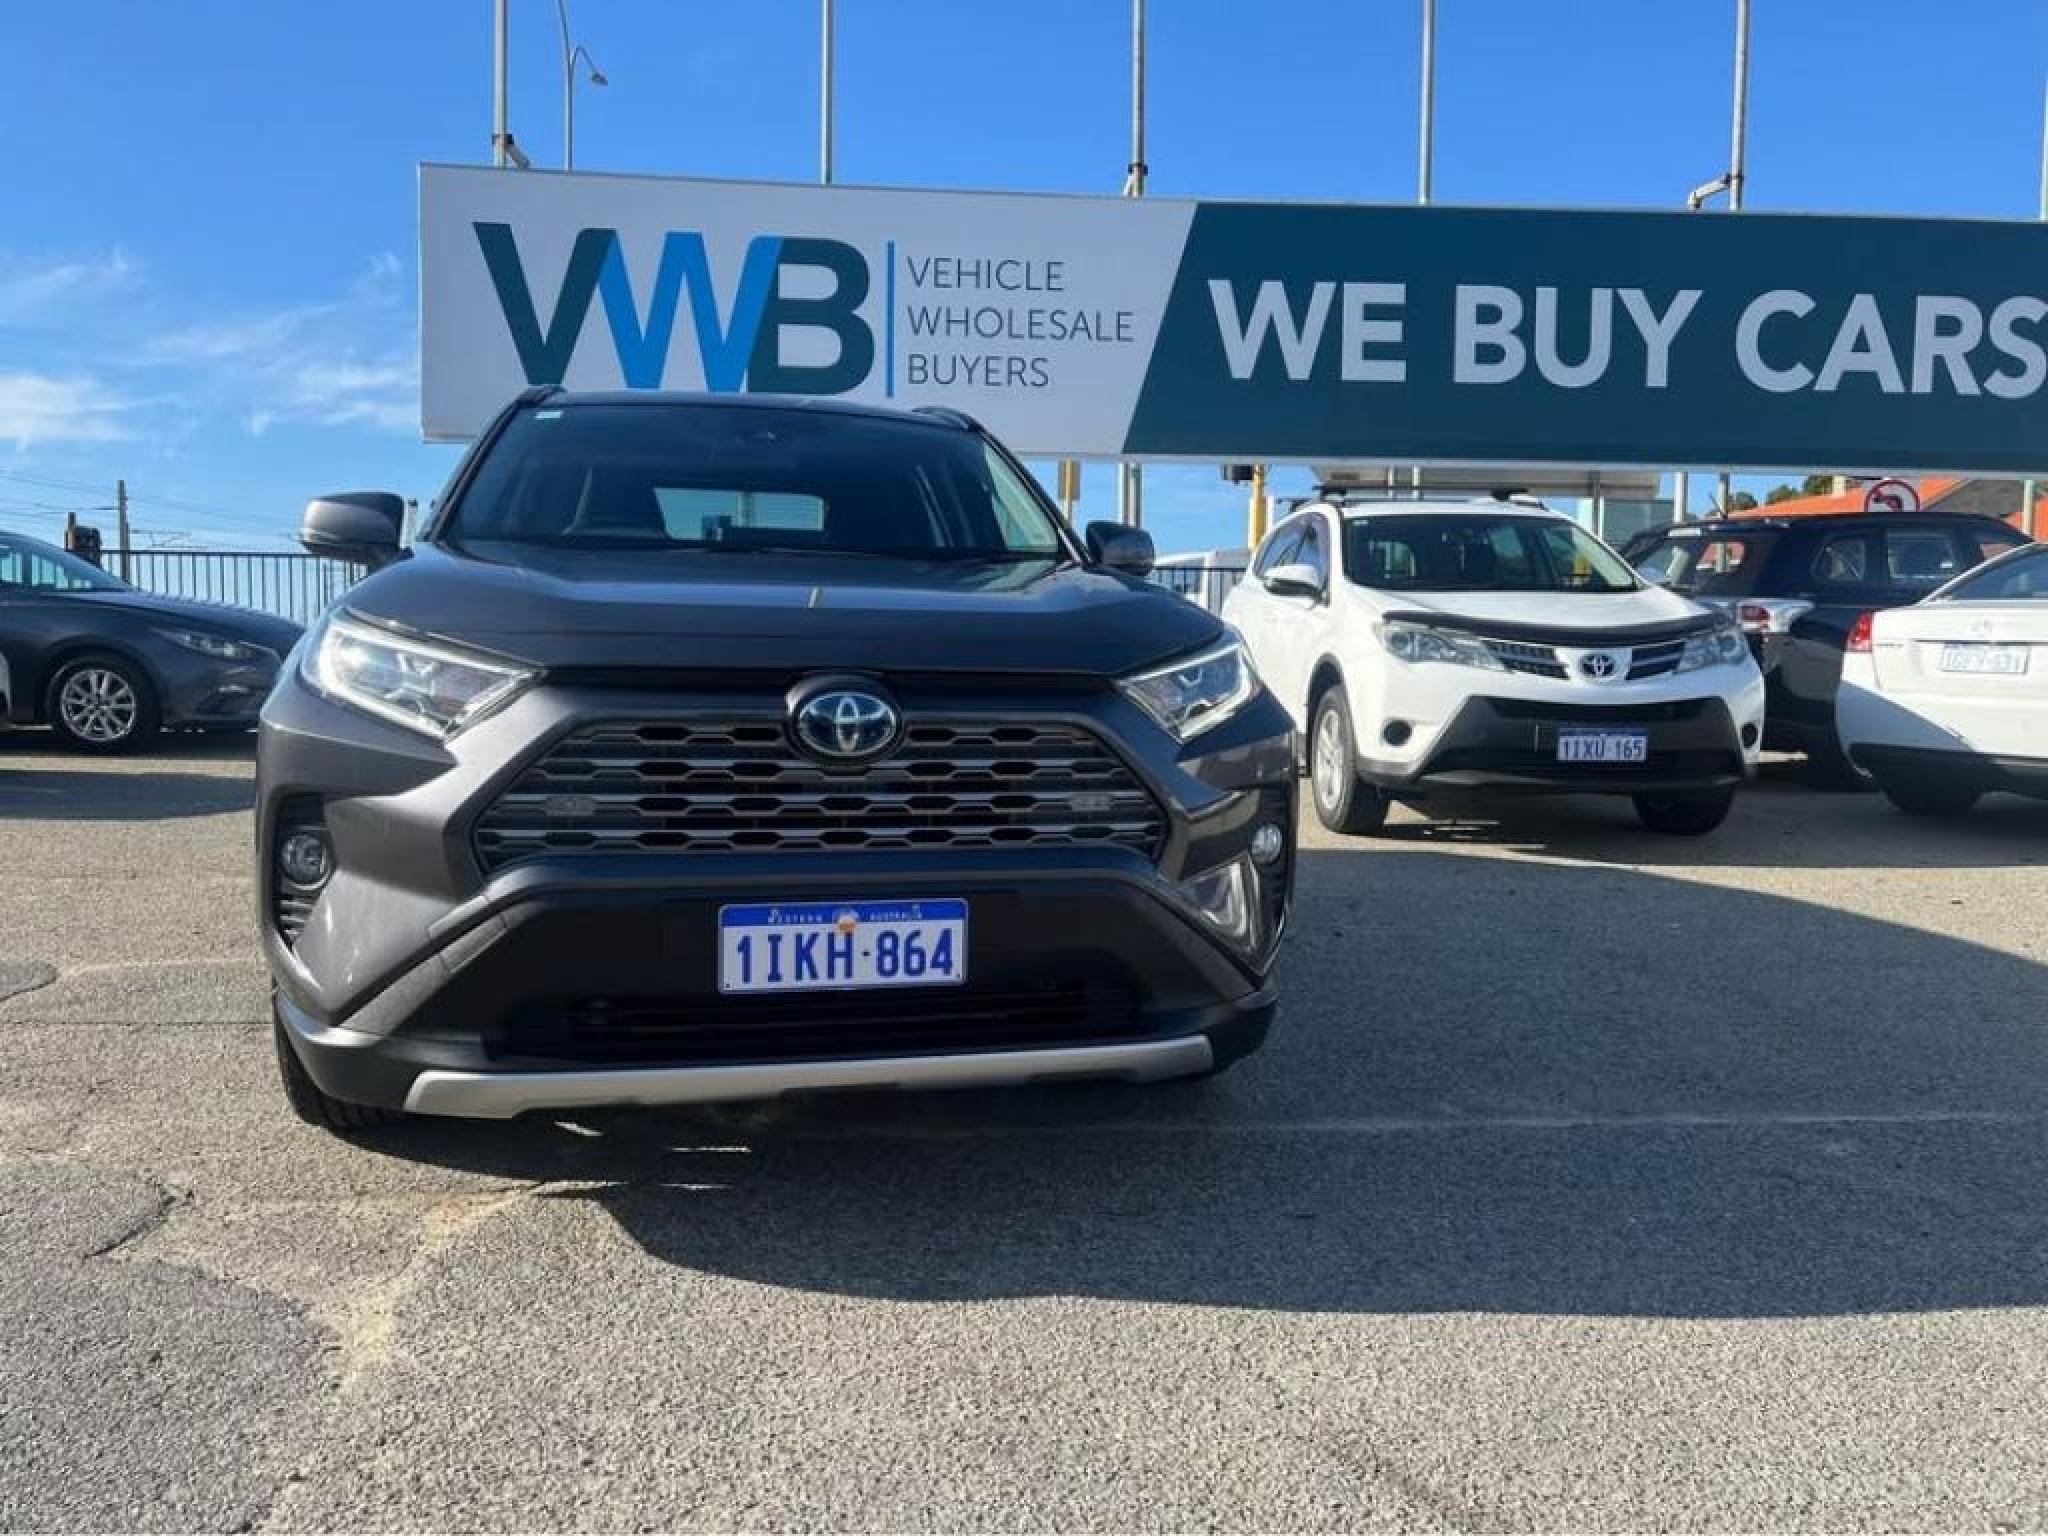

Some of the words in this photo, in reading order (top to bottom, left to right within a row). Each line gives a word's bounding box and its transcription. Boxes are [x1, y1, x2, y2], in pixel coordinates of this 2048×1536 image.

[906, 255, 1064, 293] VEHICLE
[907, 305, 1133, 343] WHOLESALE
[1208, 279, 1407, 382] WE
[1453, 285, 1704, 389] BUY
[1735, 288, 2048, 400] CARS
[907, 353, 1049, 389] BUYERS
